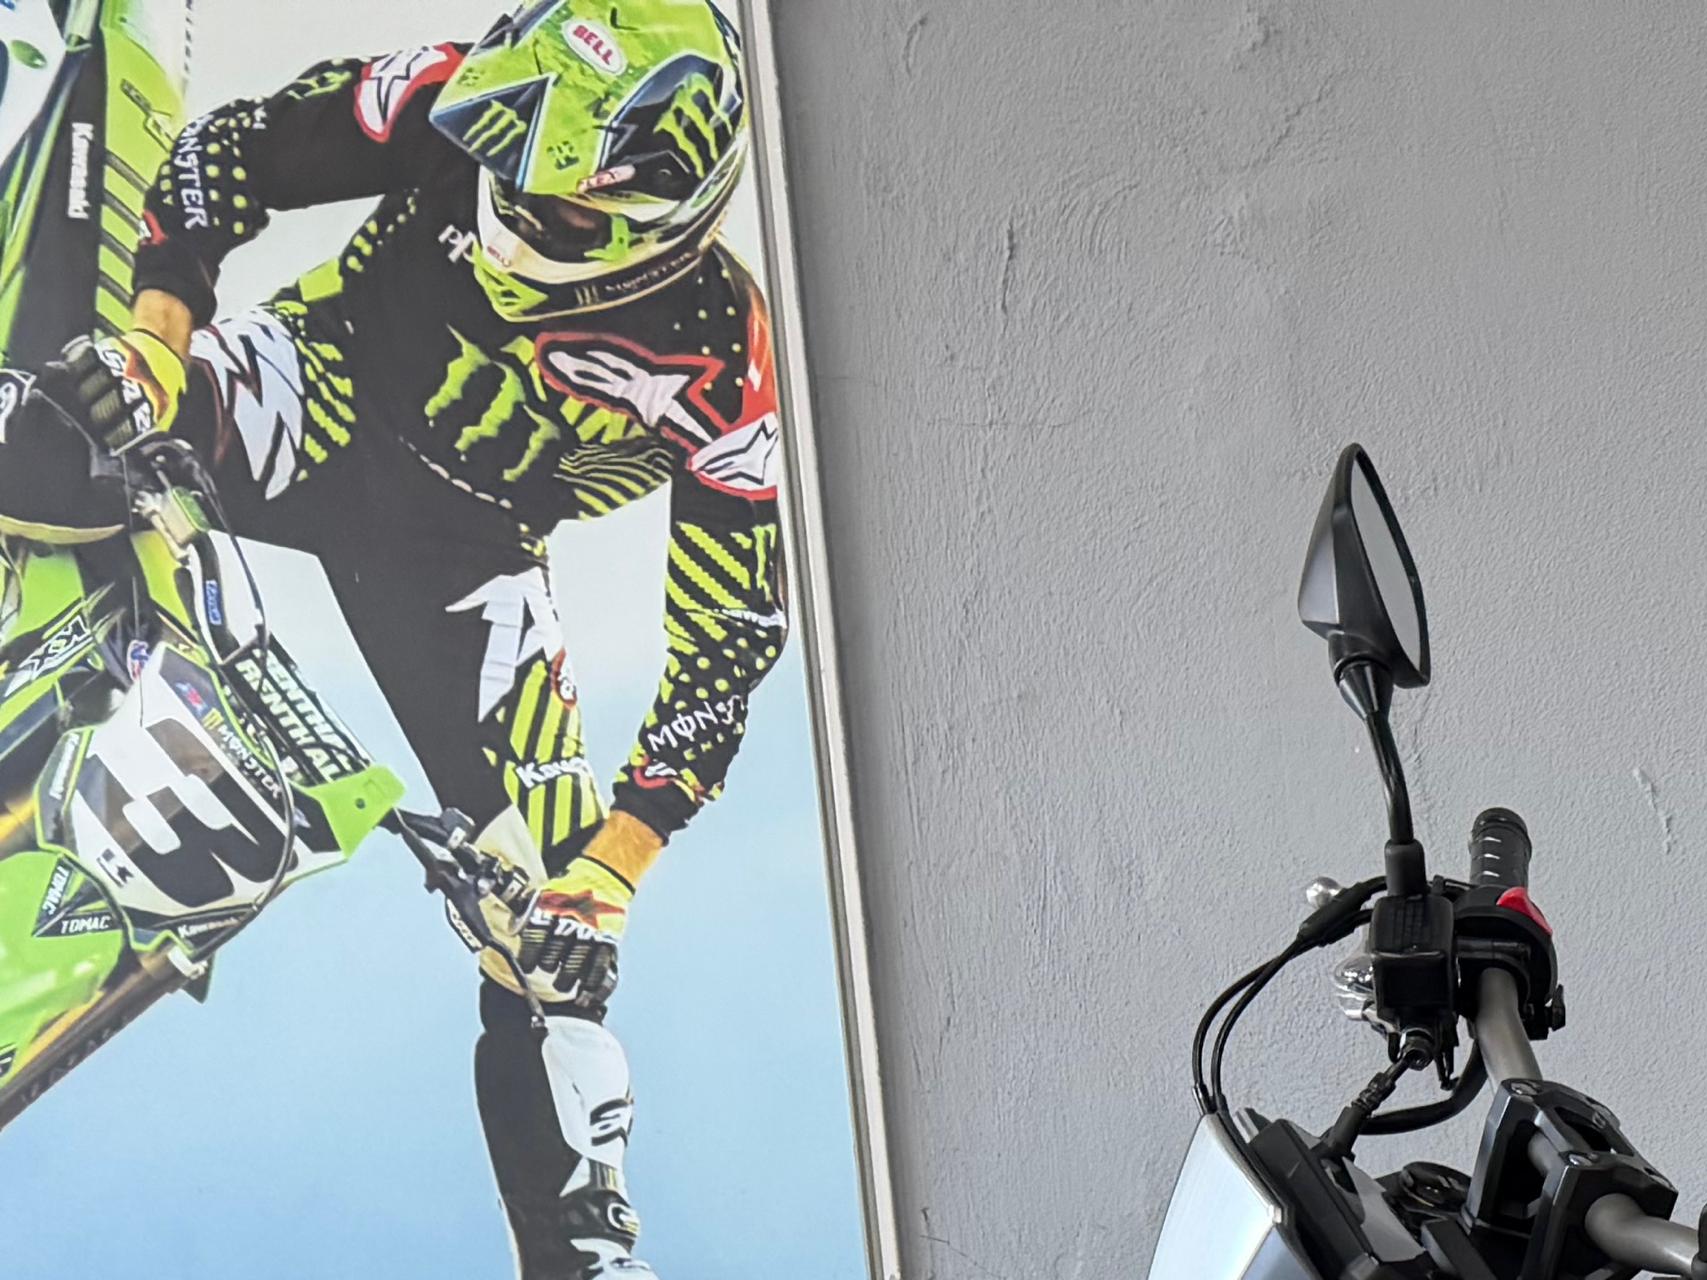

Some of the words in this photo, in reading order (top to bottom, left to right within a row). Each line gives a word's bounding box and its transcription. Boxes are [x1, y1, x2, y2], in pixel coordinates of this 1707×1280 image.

[573, 24, 614, 65] BELL
[234, 658, 344, 784] RENTHAL
[60, 915, 112, 934] TOMAC
